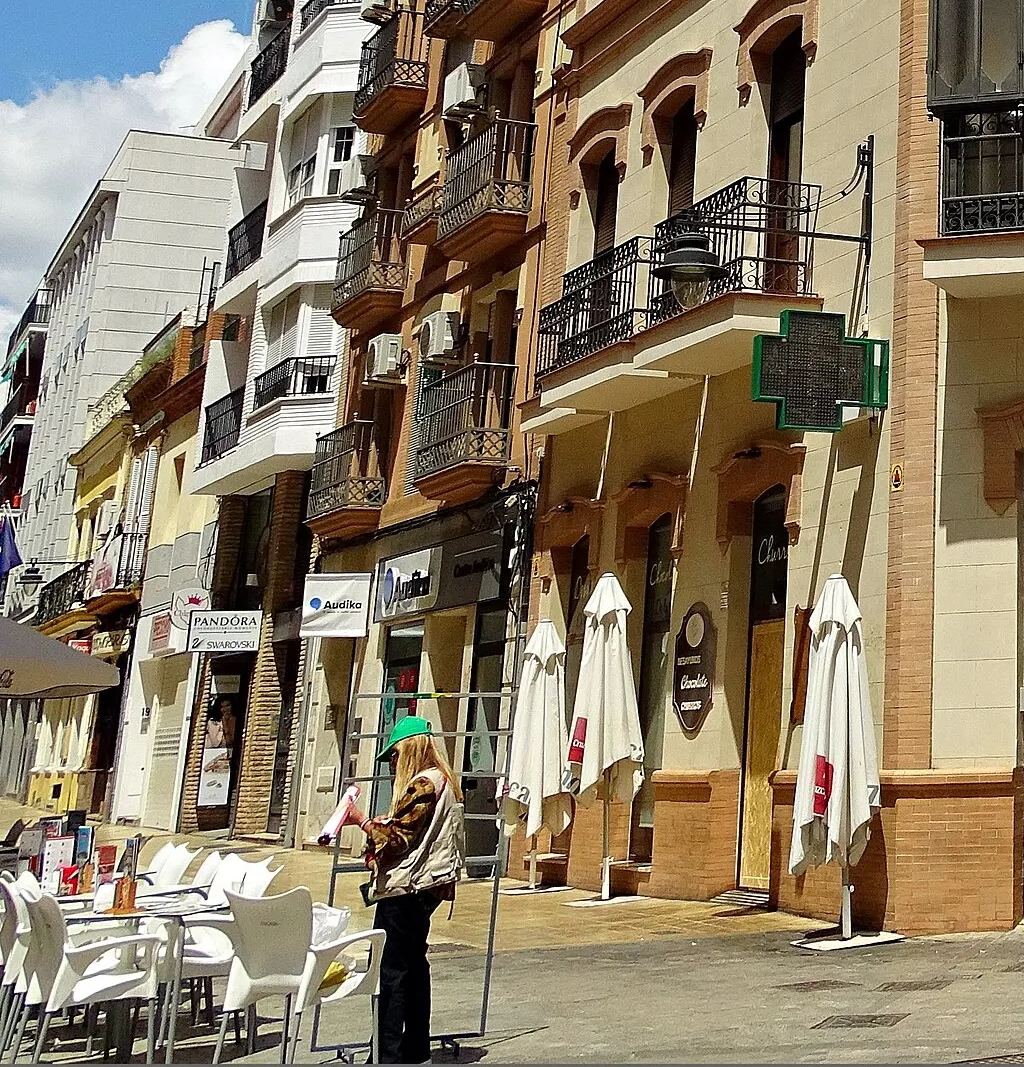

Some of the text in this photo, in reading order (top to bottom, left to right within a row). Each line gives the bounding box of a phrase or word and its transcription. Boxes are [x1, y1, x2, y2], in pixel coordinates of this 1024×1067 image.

[323, 599, 362, 609] Audika
[206, 640, 255, 649] SWAROVSKI
[141, 707, 151, 717] 19
